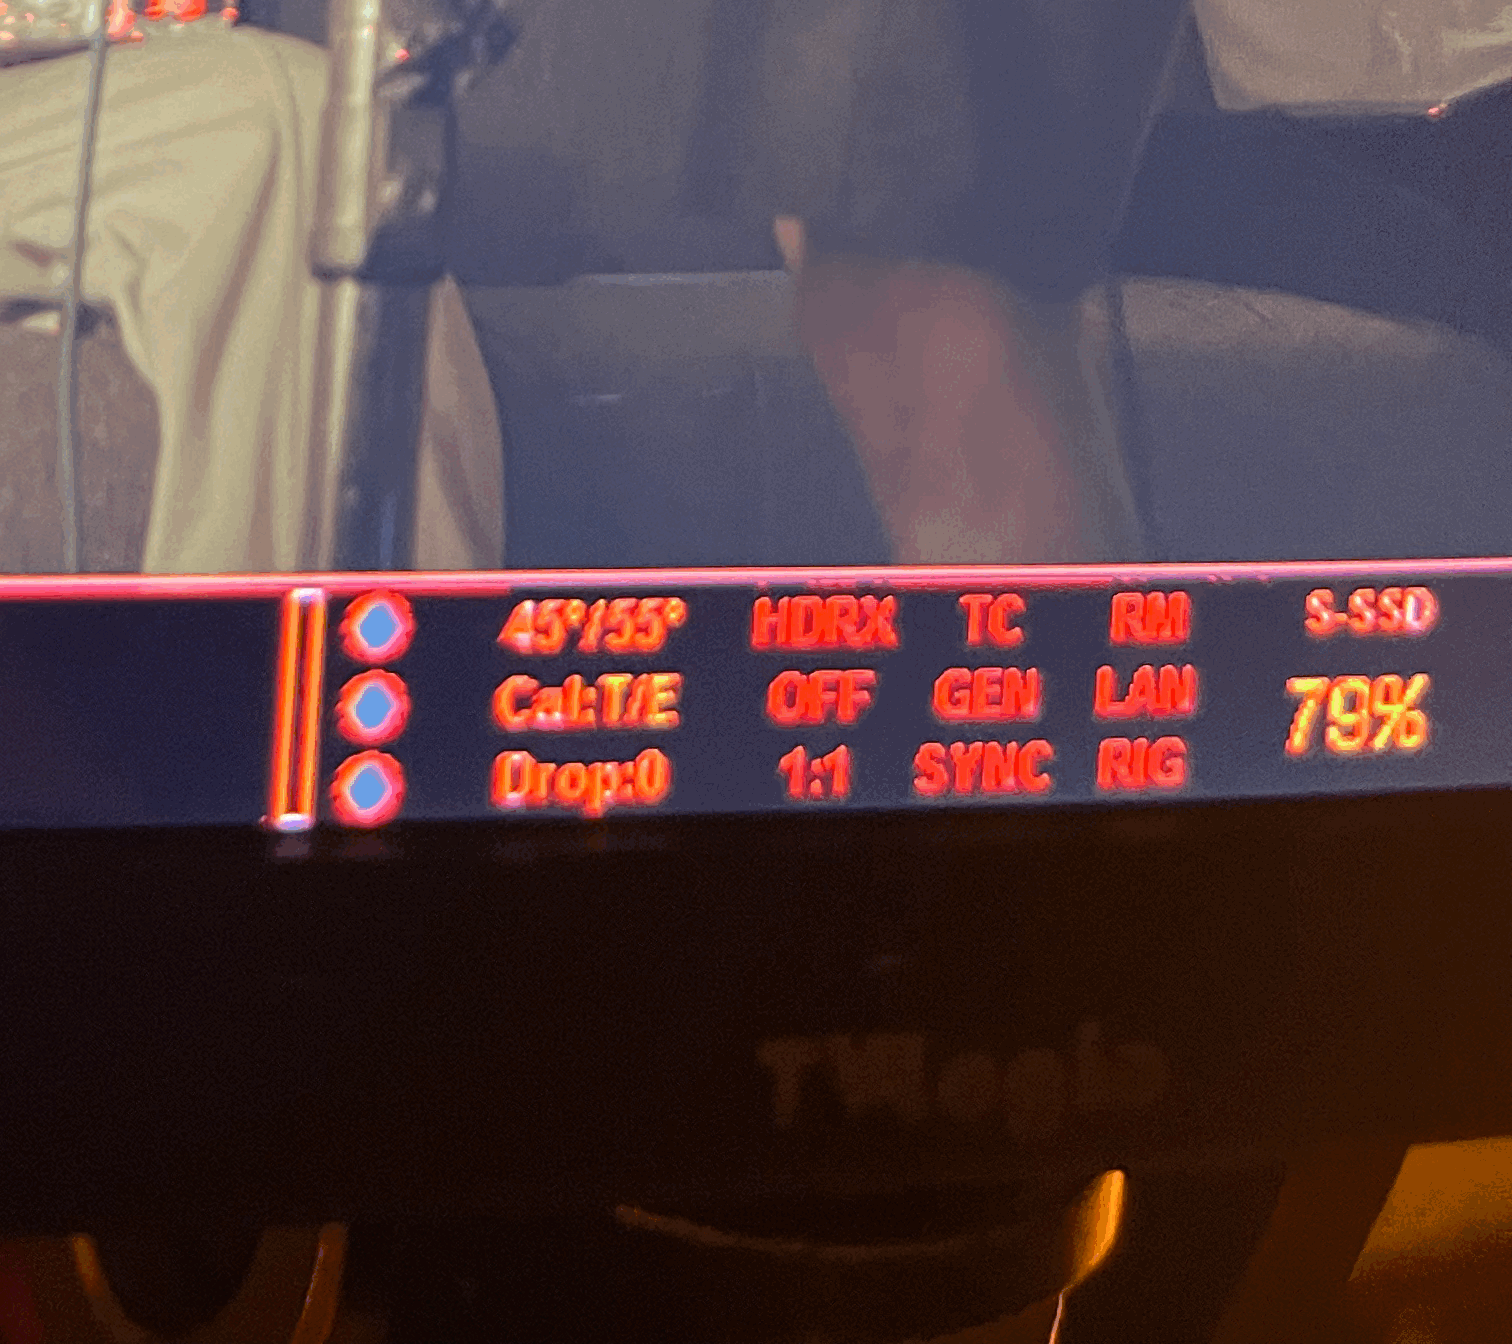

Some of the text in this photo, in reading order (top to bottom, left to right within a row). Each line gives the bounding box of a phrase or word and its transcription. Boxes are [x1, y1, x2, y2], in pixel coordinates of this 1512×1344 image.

[751, 595, 898, 650] HDRX
[959, 592, 1026, 647] TC
[1305, 587, 1439, 638] S-SSD
[766, 669, 877, 725] OFF
[932, 666, 1042, 723] GEN
[1093, 664, 1198, 717] LAN
[1284, 672, 1431, 758] 79%
[491, 748, 672, 817] Drop:0
[779, 744, 851, 799] 1:1
[913, 739, 1054, 797] SYNC
[1096, 736, 1188, 792] RIG
